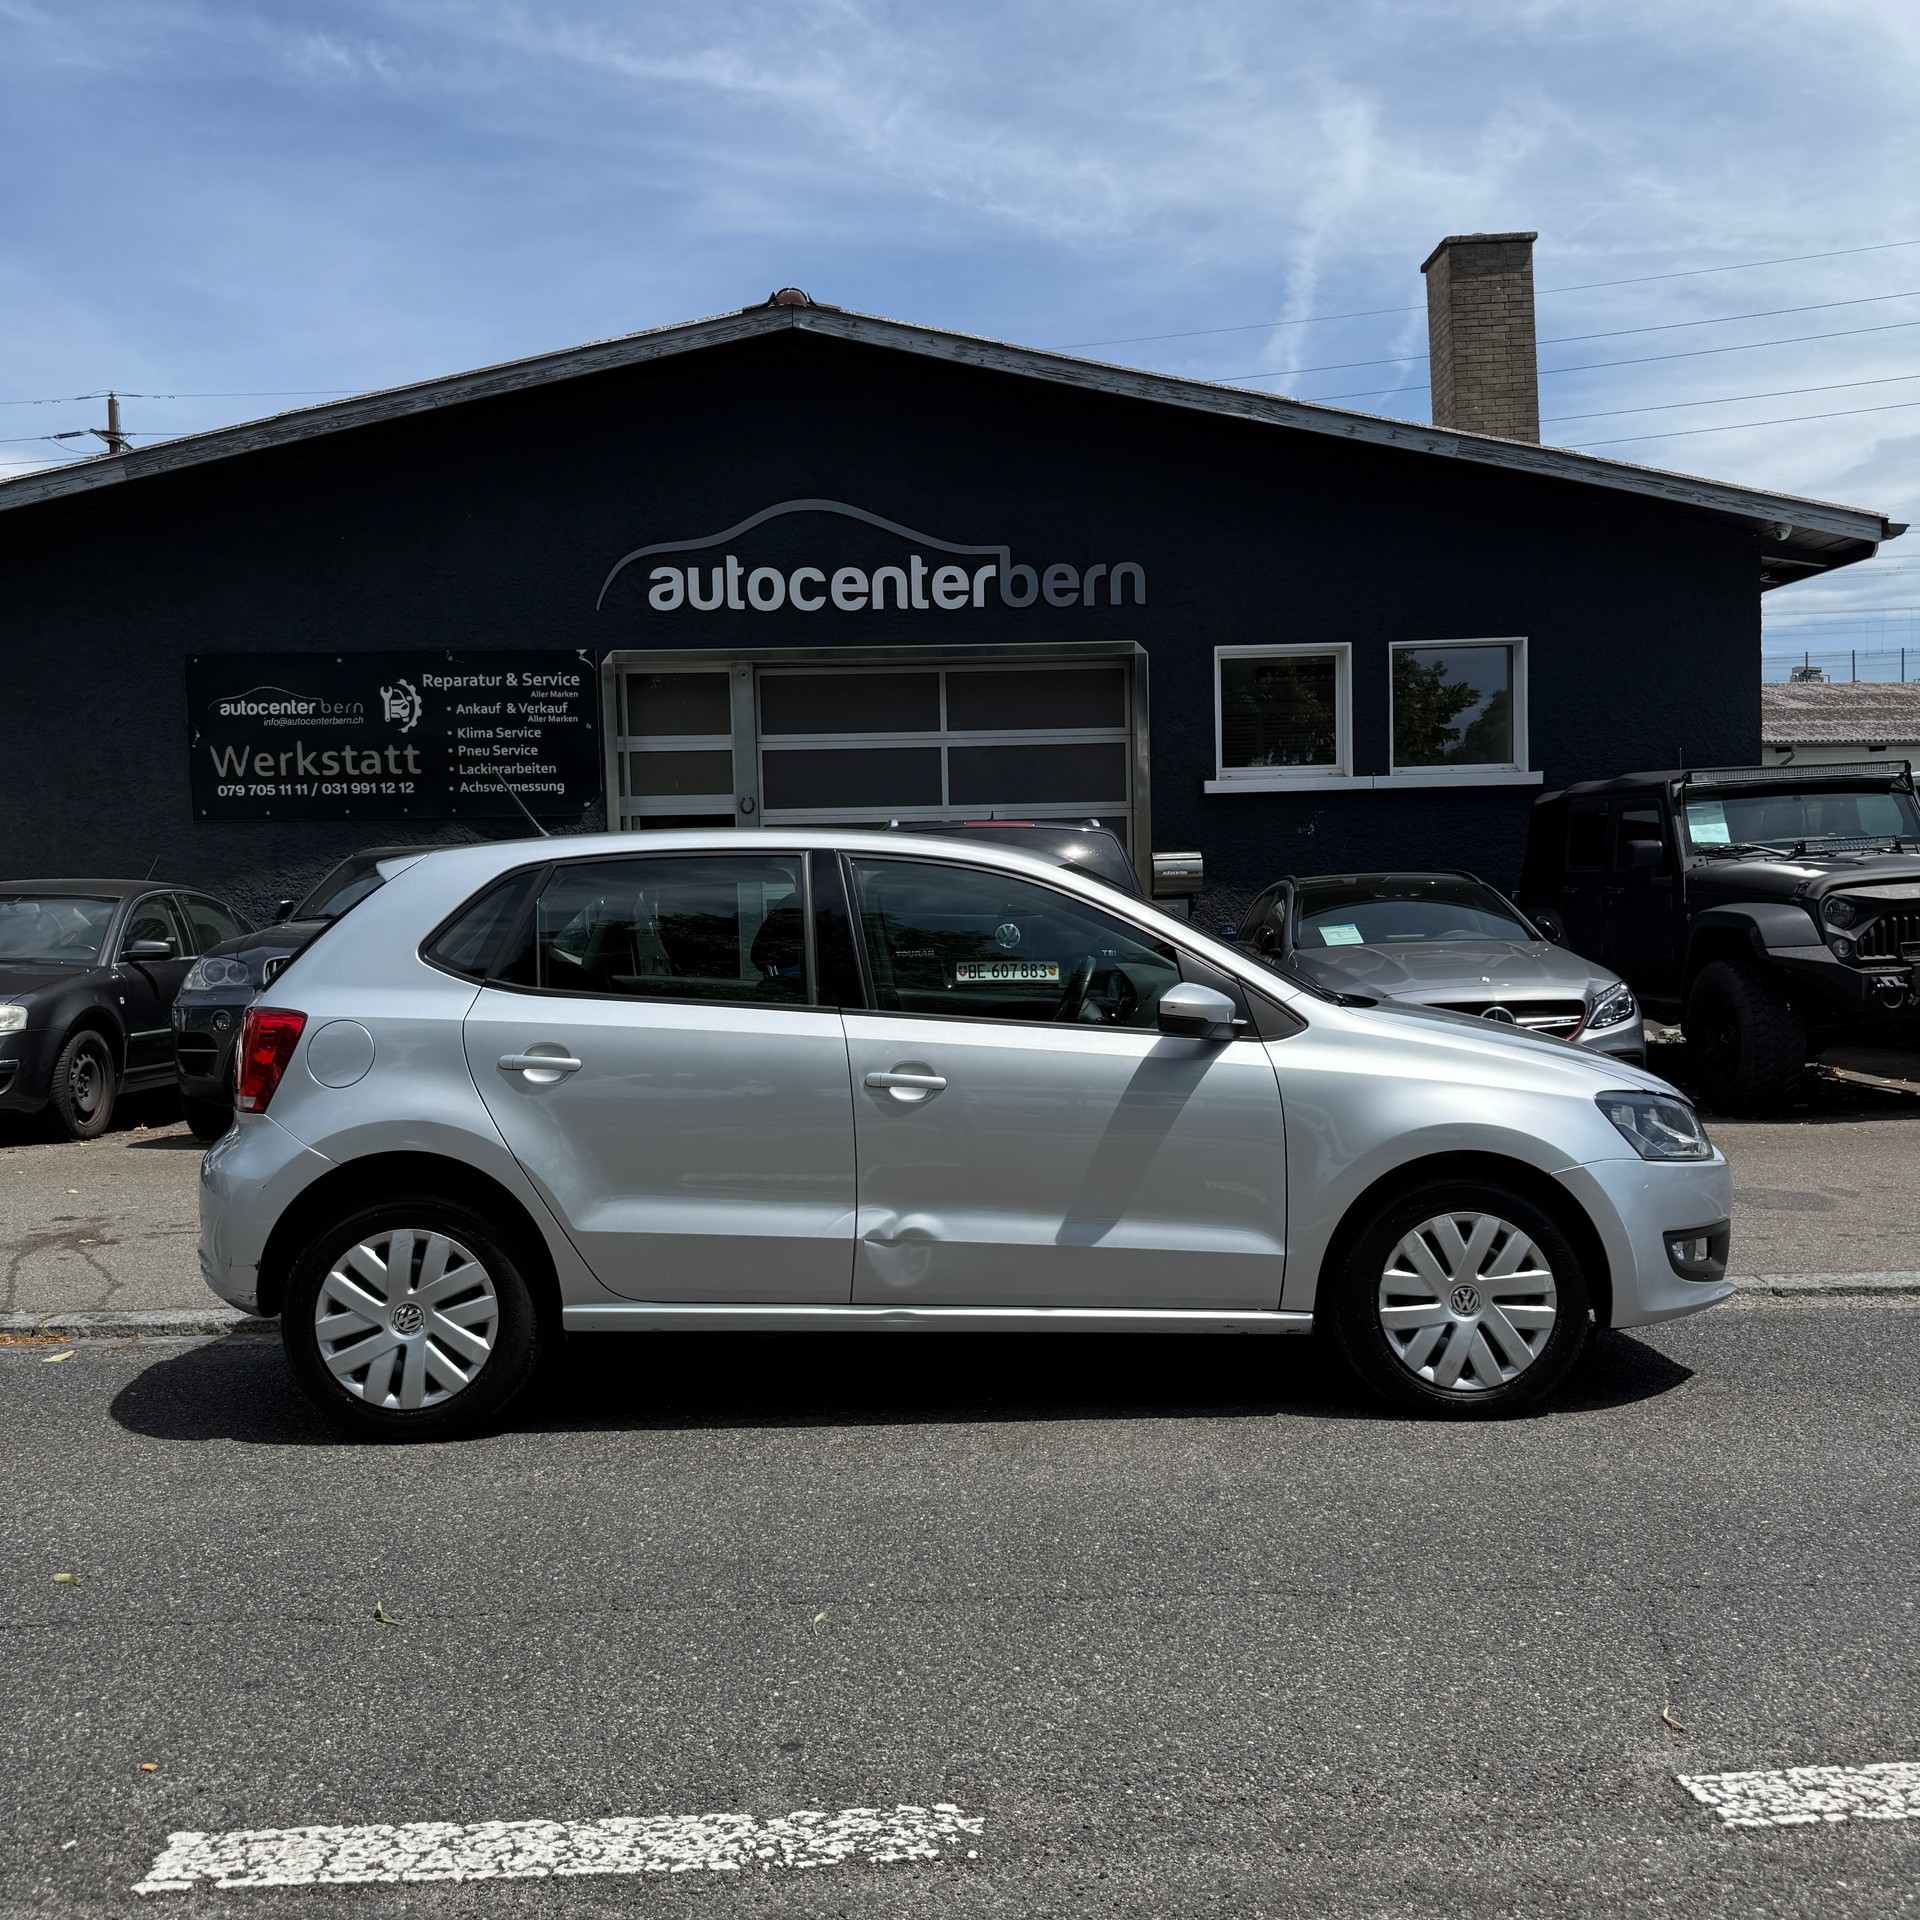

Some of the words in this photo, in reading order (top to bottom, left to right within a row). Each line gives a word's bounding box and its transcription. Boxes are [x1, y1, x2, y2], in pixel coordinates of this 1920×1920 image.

[422, 673, 502, 692] Reparatur
[505, 672, 518, 686] &
[522, 671, 580, 686] Service
[530, 690, 549, 698] Aller
[550, 690, 579, 698] Marken
[456, 702, 502, 715] Ankauf
[506, 702, 516, 714] &
[518, 701, 568, 714] Verkauf
[263, 716, 364, 727] info@autocenterbern.ch
[527, 715, 547, 723] Aller
[548, 714, 578, 723] Marken
[457, 726, 493, 739] Klima
[496, 726, 542, 738] Service
[458, 745, 490, 756] Pneu
[492, 744, 538, 756] Service
[209, 740, 422, 778] Werkstatt
[459, 762, 557, 775] Lackierarbeiten
[217, 785, 245, 796] 079
[248, 784, 275, 796] 705
[279, 784, 292, 795] 11
[295, 783, 308, 795] 11
[311, 782, 318, 797] /
[321, 782, 348, 795] 031
[351, 782, 377, 794] 991
[380, 782, 396, 794] 12
[399, 782, 415, 793] 12
